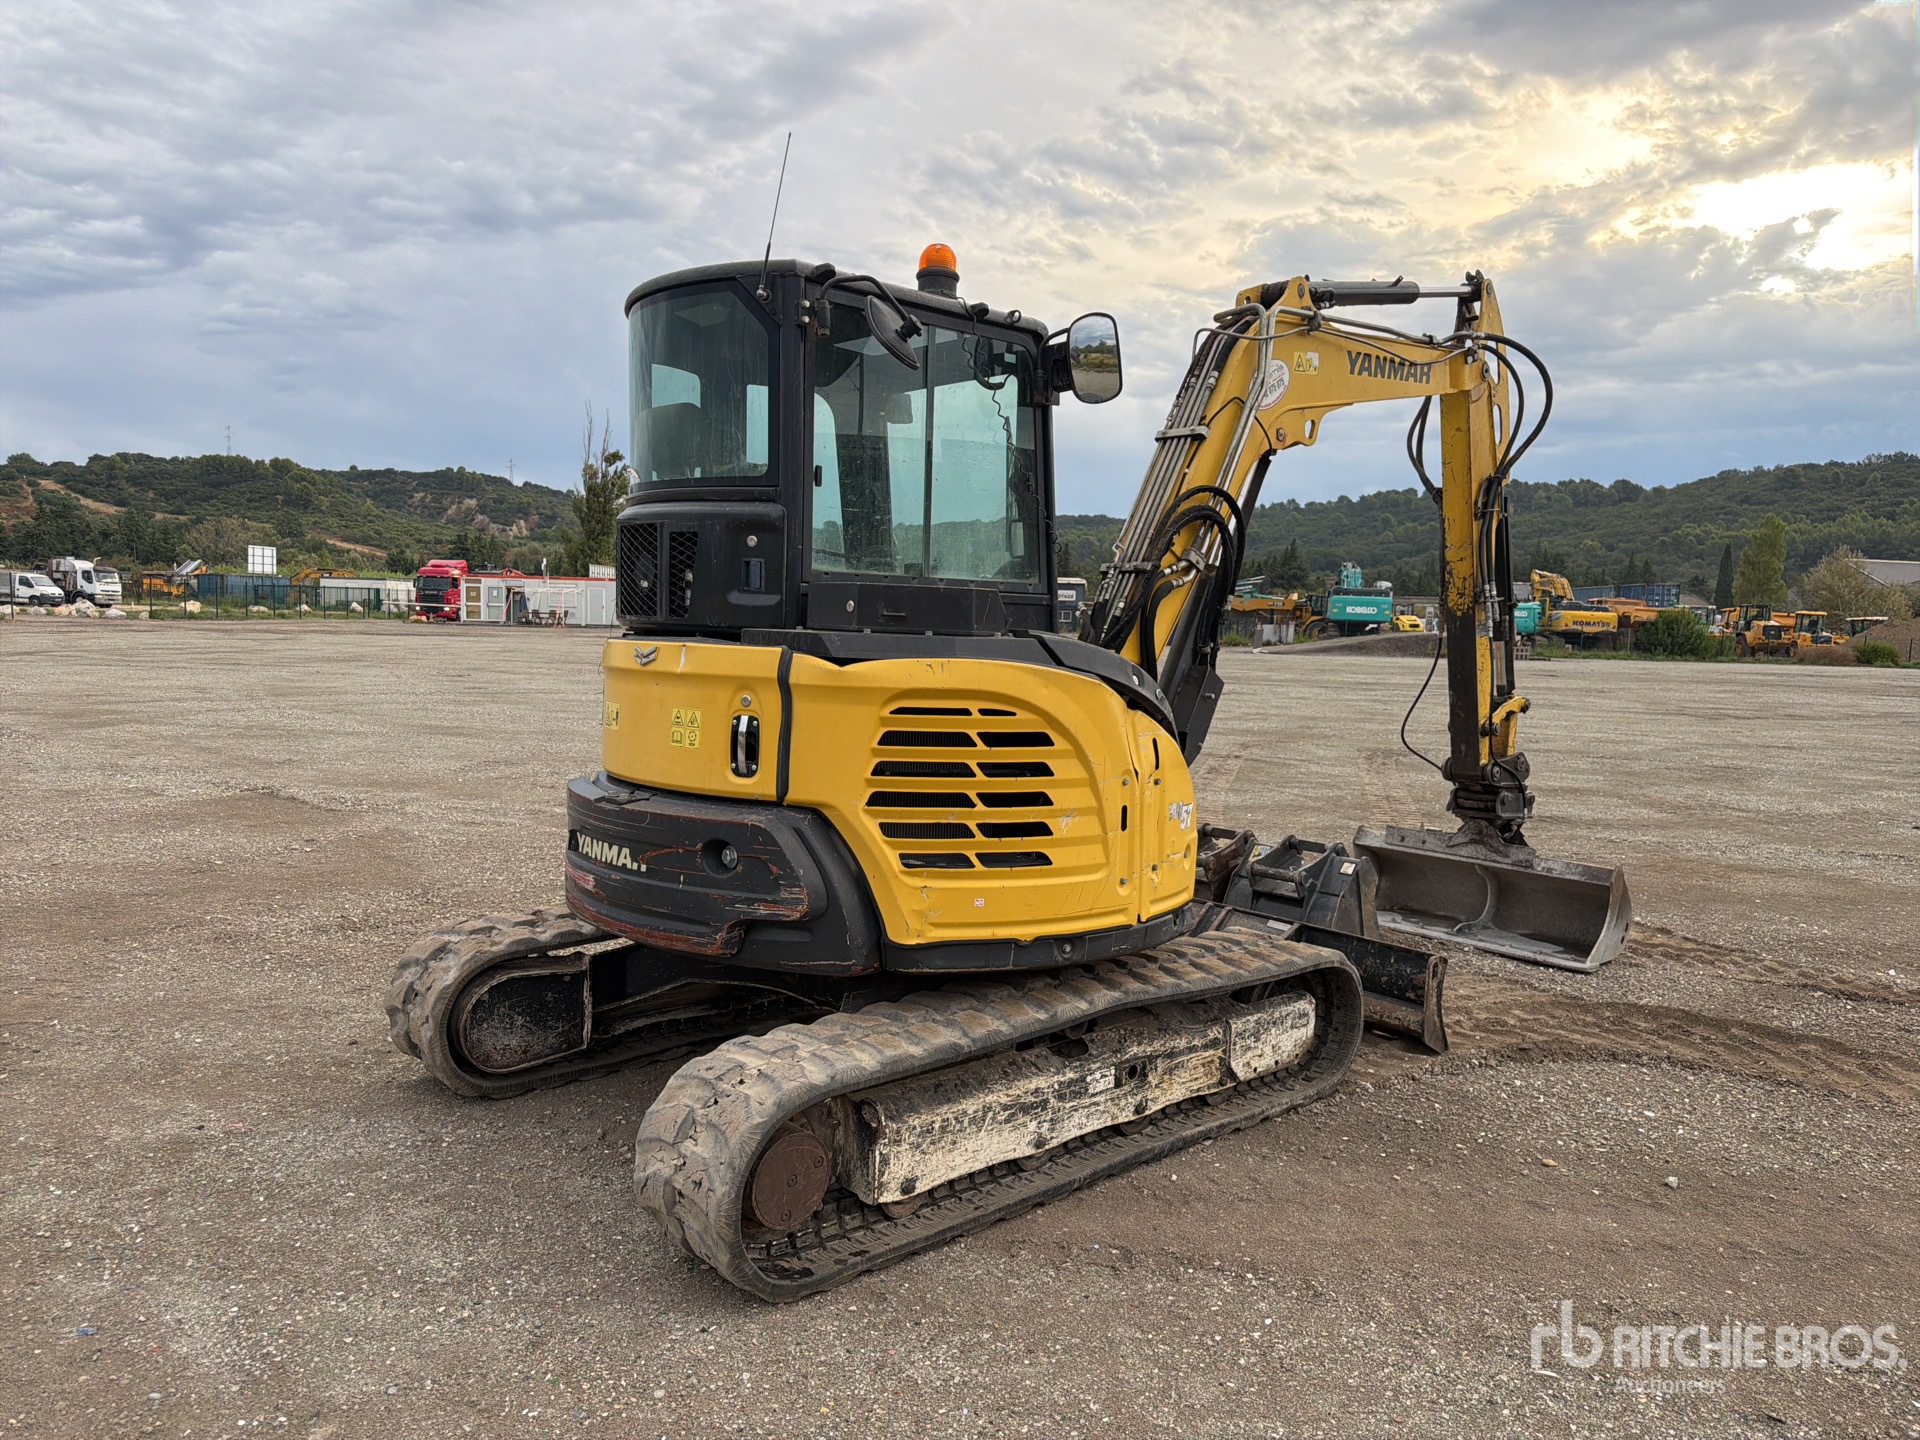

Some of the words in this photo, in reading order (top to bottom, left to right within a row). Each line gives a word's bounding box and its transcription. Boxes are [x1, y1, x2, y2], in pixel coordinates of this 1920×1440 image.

[1346, 350, 1432, 385] YANMAR
[1346, 606, 1377, 614] KOBELCO
[1572, 620, 1611, 628] KOMATSU
